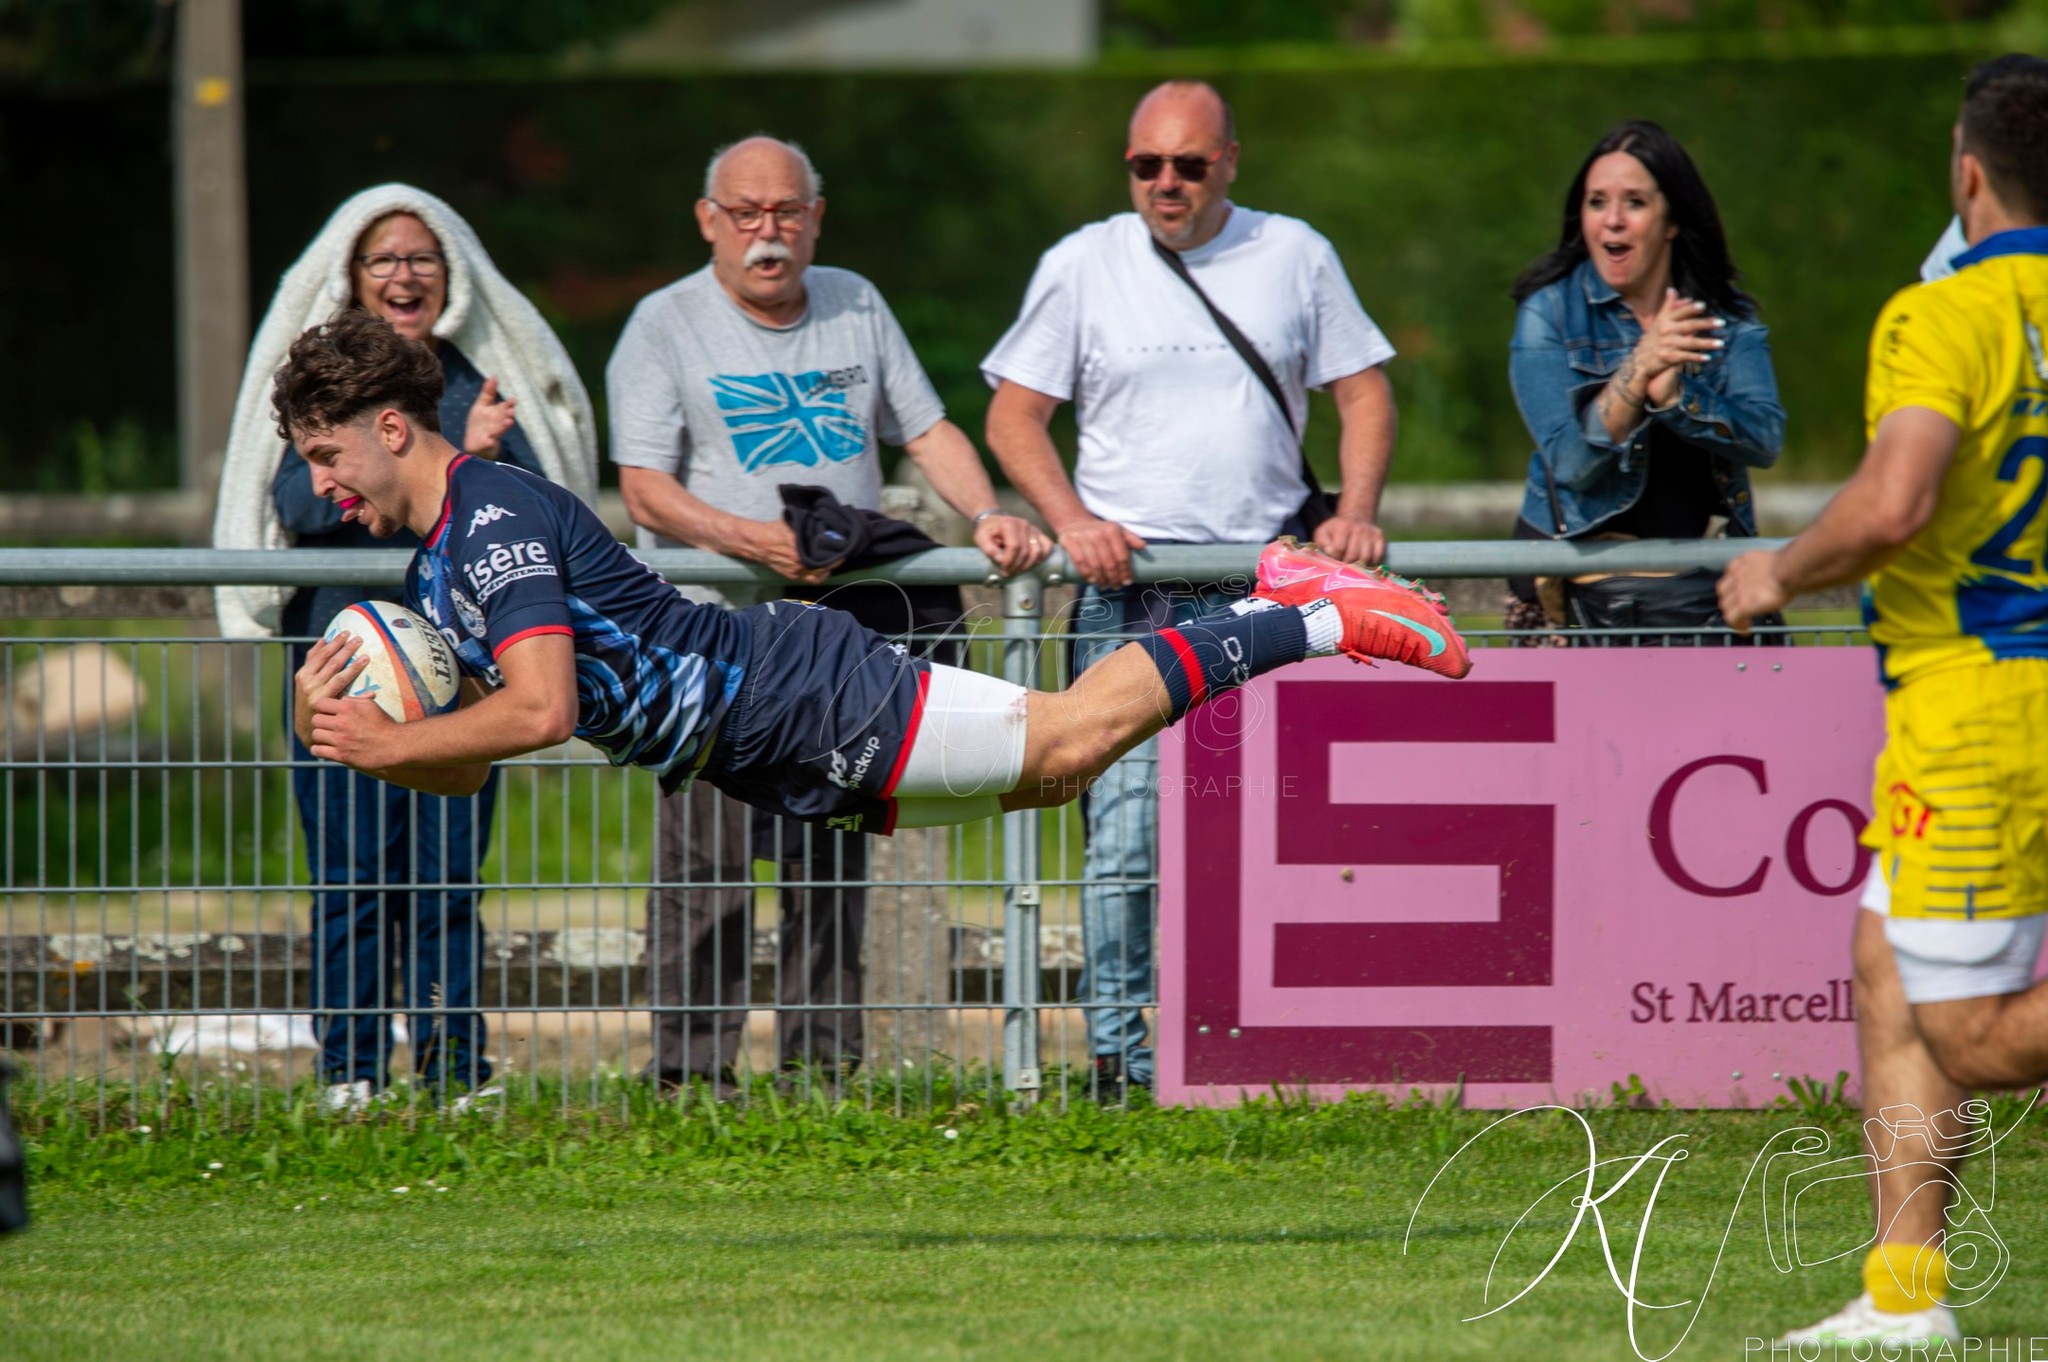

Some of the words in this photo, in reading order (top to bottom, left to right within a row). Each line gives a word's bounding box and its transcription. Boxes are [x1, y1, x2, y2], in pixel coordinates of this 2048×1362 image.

[1969, 434, 2048, 577] 2
[463, 541, 549, 591] isère
[1631, 981, 1674, 1023] St
